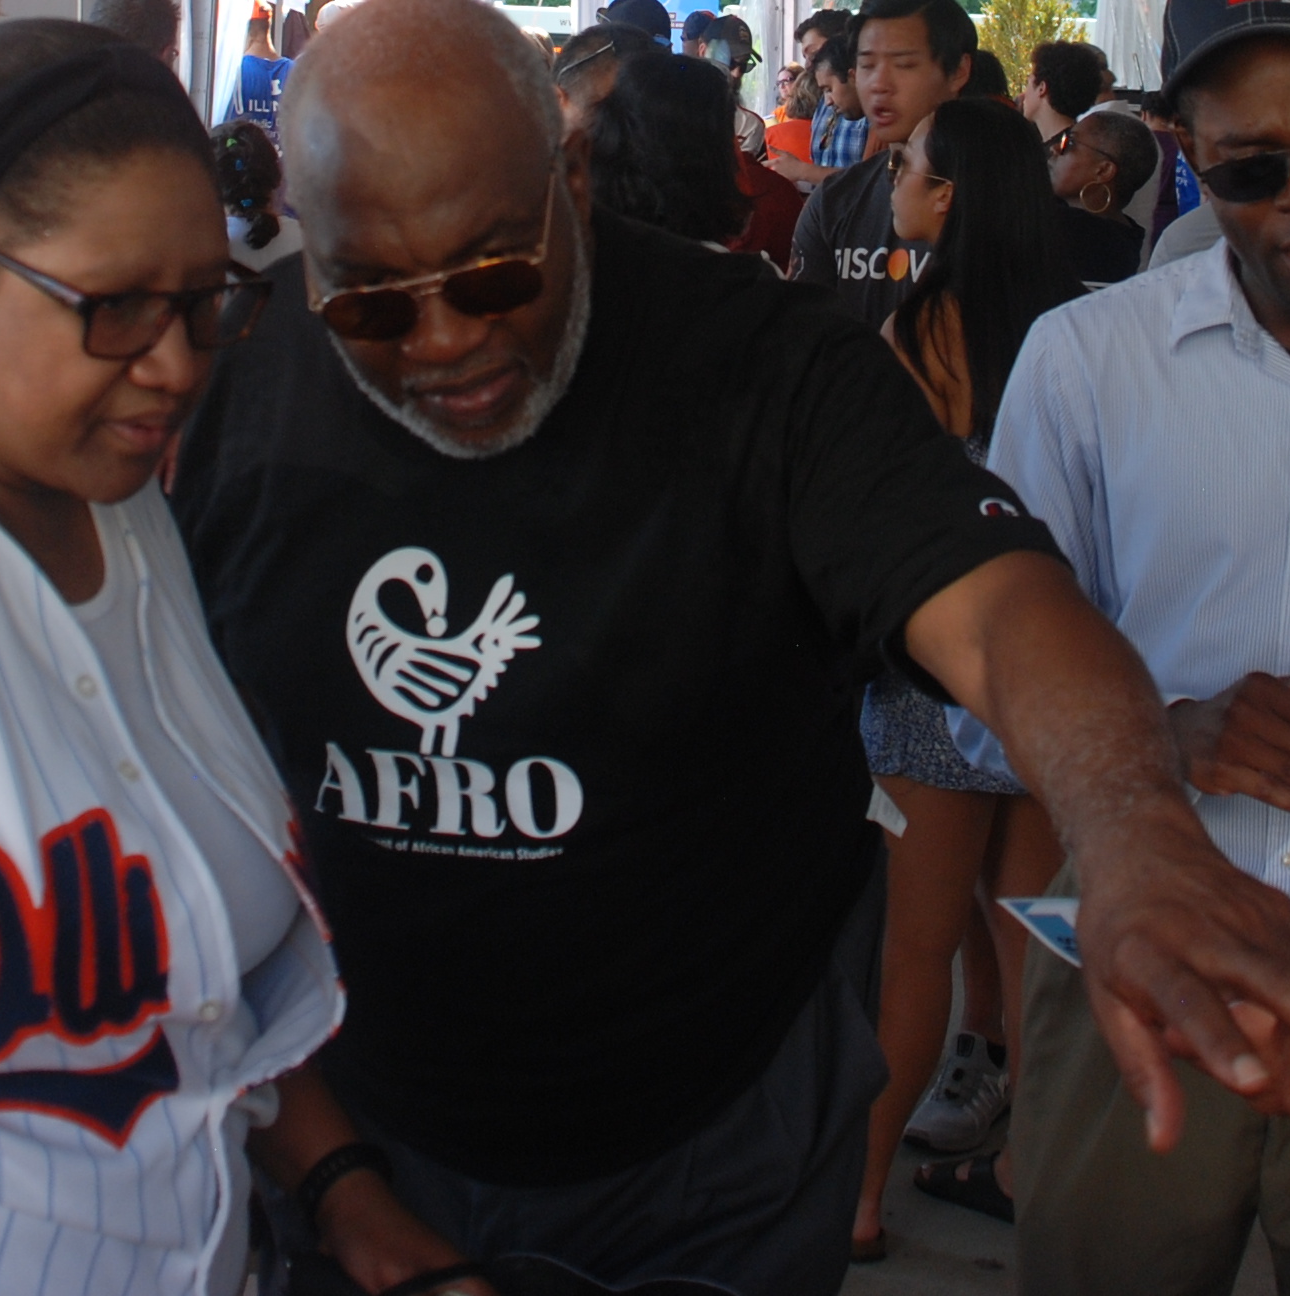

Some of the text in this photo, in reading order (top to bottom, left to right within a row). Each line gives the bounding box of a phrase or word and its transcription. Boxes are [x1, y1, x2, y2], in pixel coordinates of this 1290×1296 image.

[314, 740, 584, 839] AFRO
[395, 840, 409, 852] of
[411, 840, 455, 855] African
[457, 846, 513, 860] American
